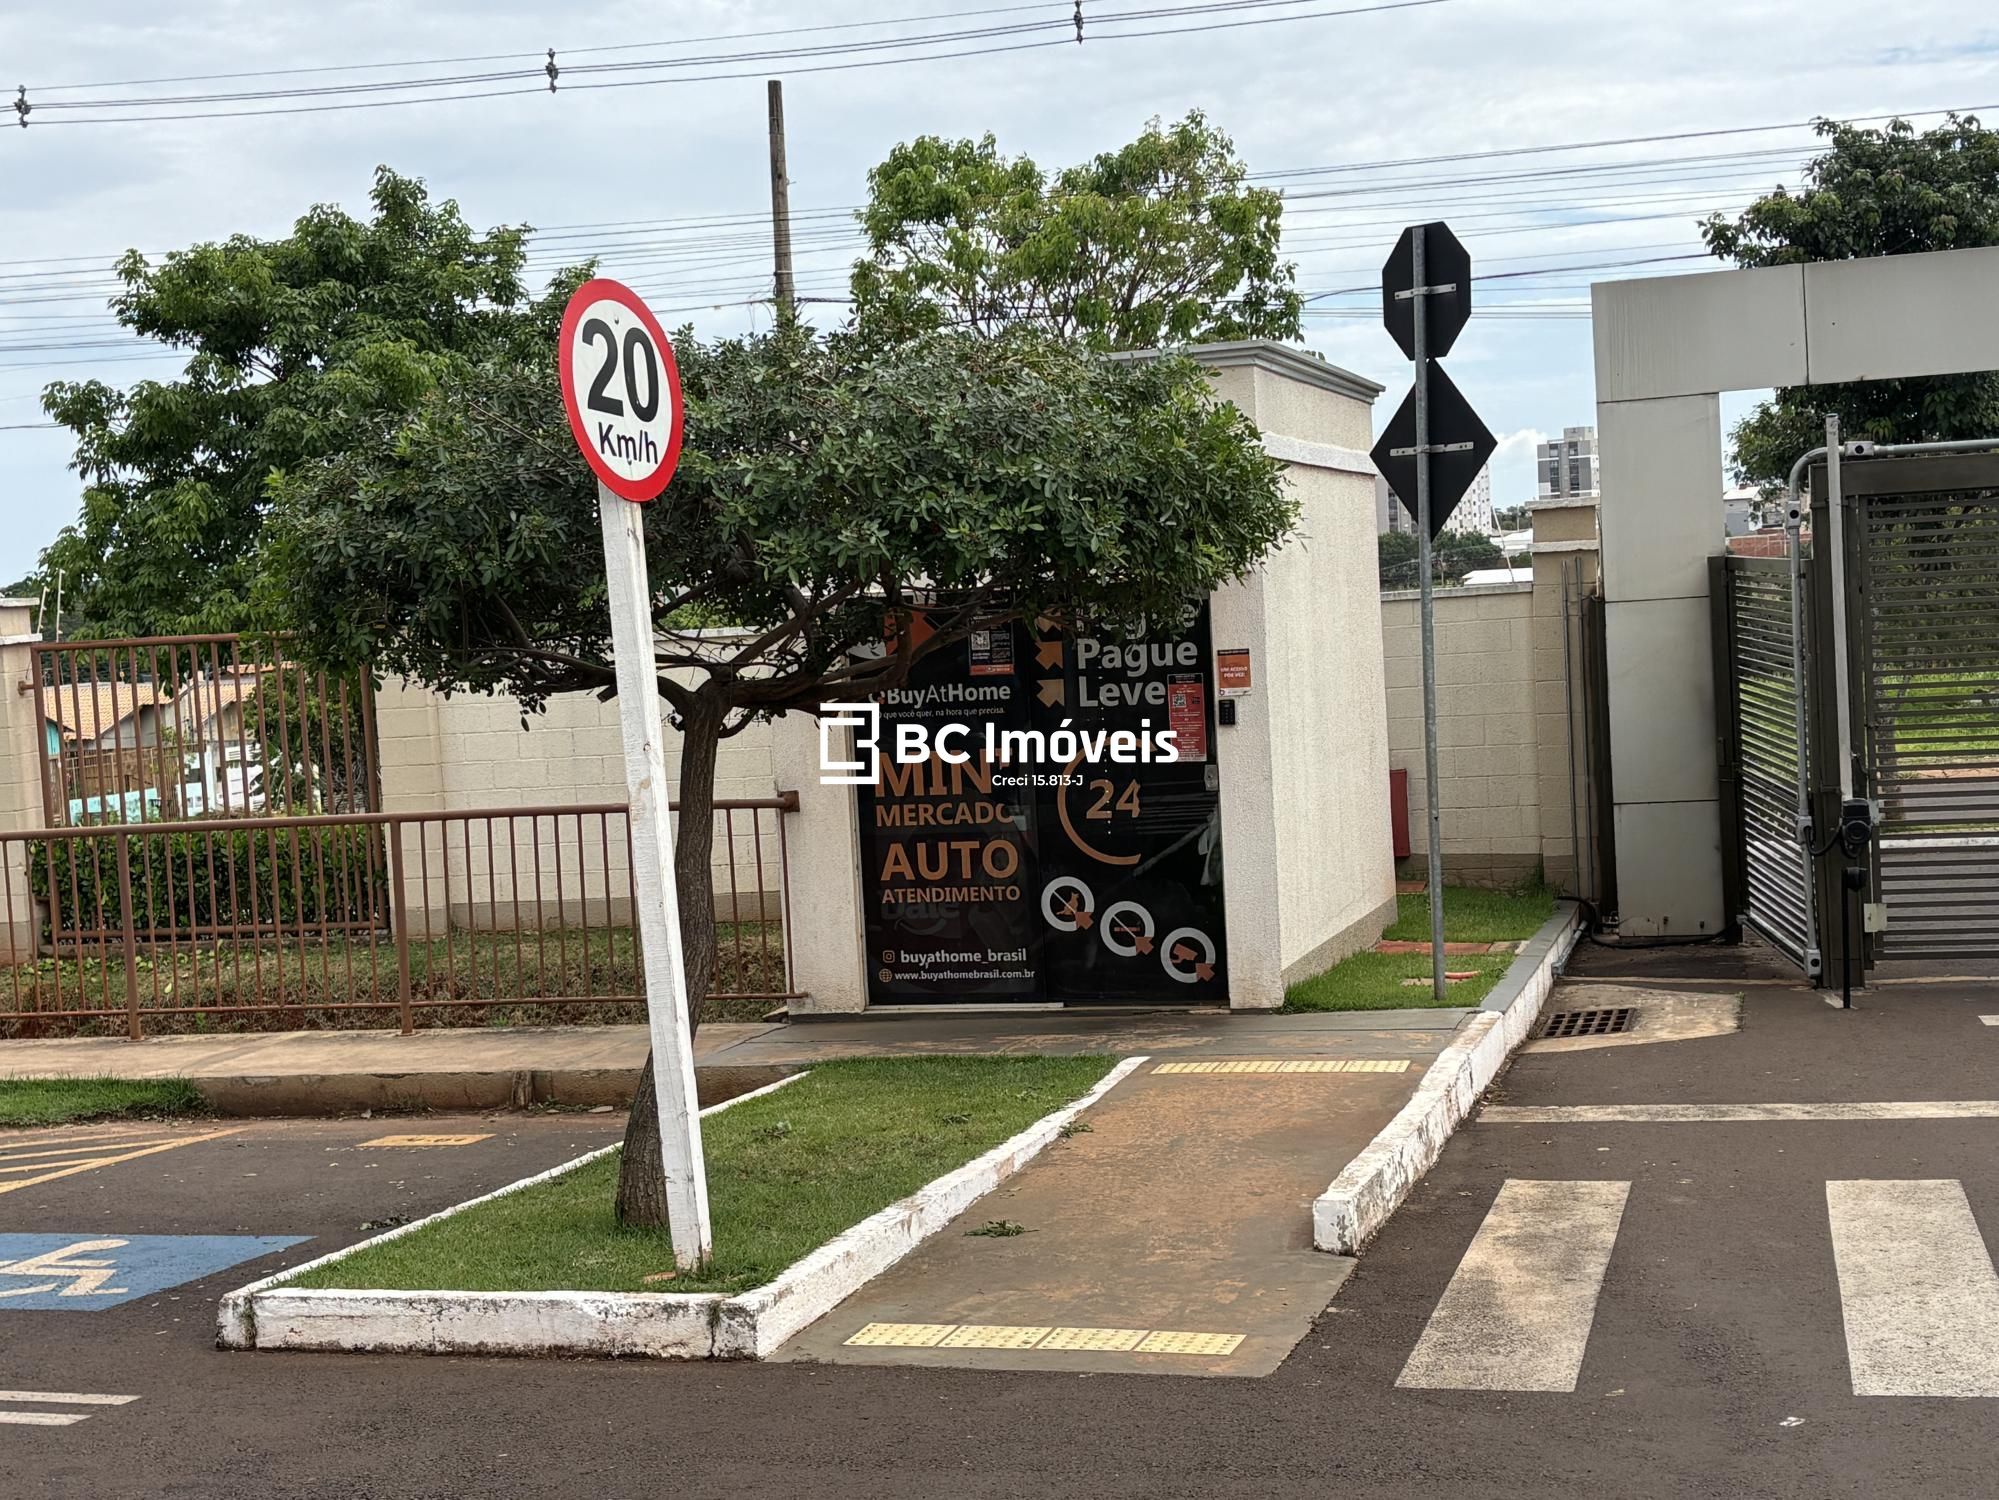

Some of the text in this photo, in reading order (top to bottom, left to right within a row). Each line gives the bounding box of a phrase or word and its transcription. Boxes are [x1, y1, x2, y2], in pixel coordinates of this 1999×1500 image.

[582, 318, 659, 422] 20
[598, 422, 658, 464] Km/h
[1077, 638, 1198, 677] Pague
[887, 683, 1011, 709] BuyAtHome
[1079, 676, 1166, 707] Leve
[883, 711, 897, 719] que
[898, 709, 915, 718] você
[916, 710, 934, 719] quer,
[945, 708, 962, 716] hora
[963, 709, 978, 717] que
[874, 748, 1013, 798] MIN
[1086, 778, 1142, 820] 24
[880, 839, 1019, 881] AUTO
[881, 886, 1021, 904] ATENDIMENTO
[894, 968, 1036, 982] www.buyathomebrasil.com.br
[900, 948, 1027, 968] buyathome_brasil
